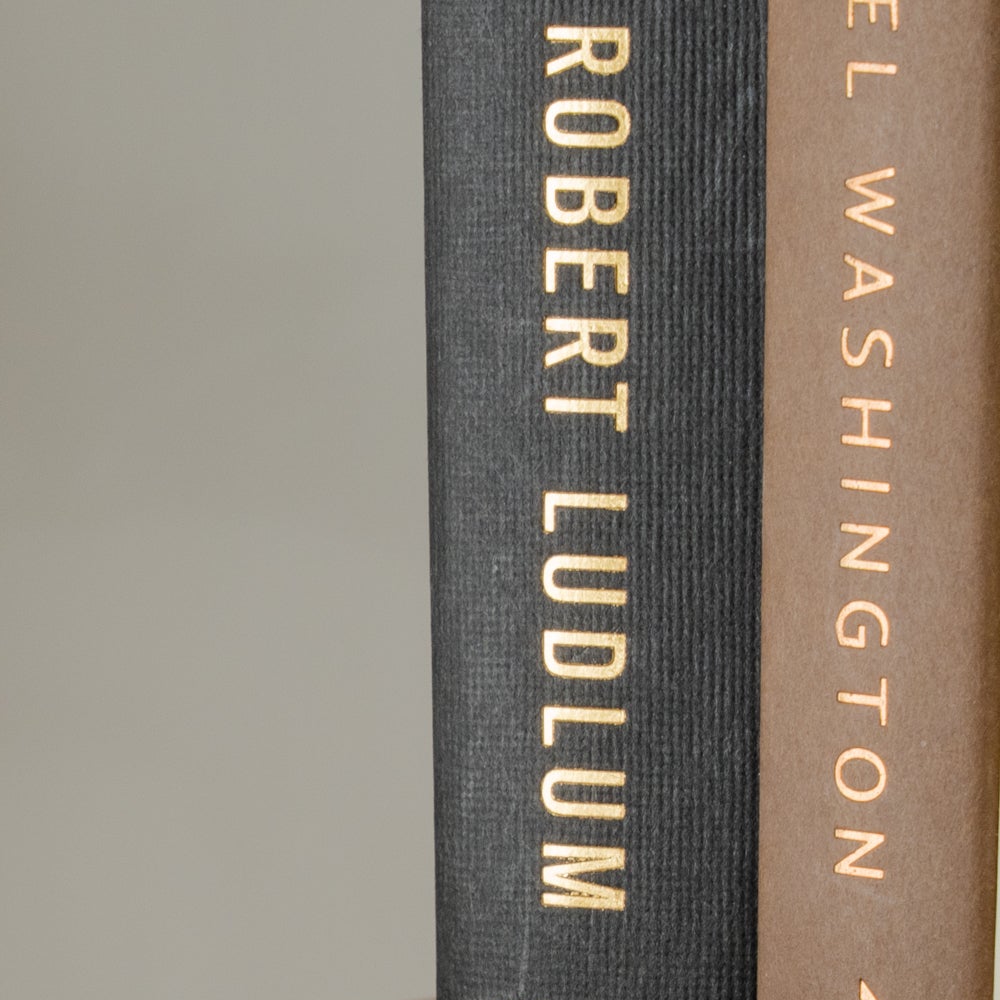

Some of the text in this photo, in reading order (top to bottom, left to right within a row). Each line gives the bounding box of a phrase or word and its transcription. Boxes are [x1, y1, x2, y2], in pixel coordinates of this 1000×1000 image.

[540, 25, 631, 912] ROBERT LUDLUM
[833, 166, 896, 880] WASHINGTON
